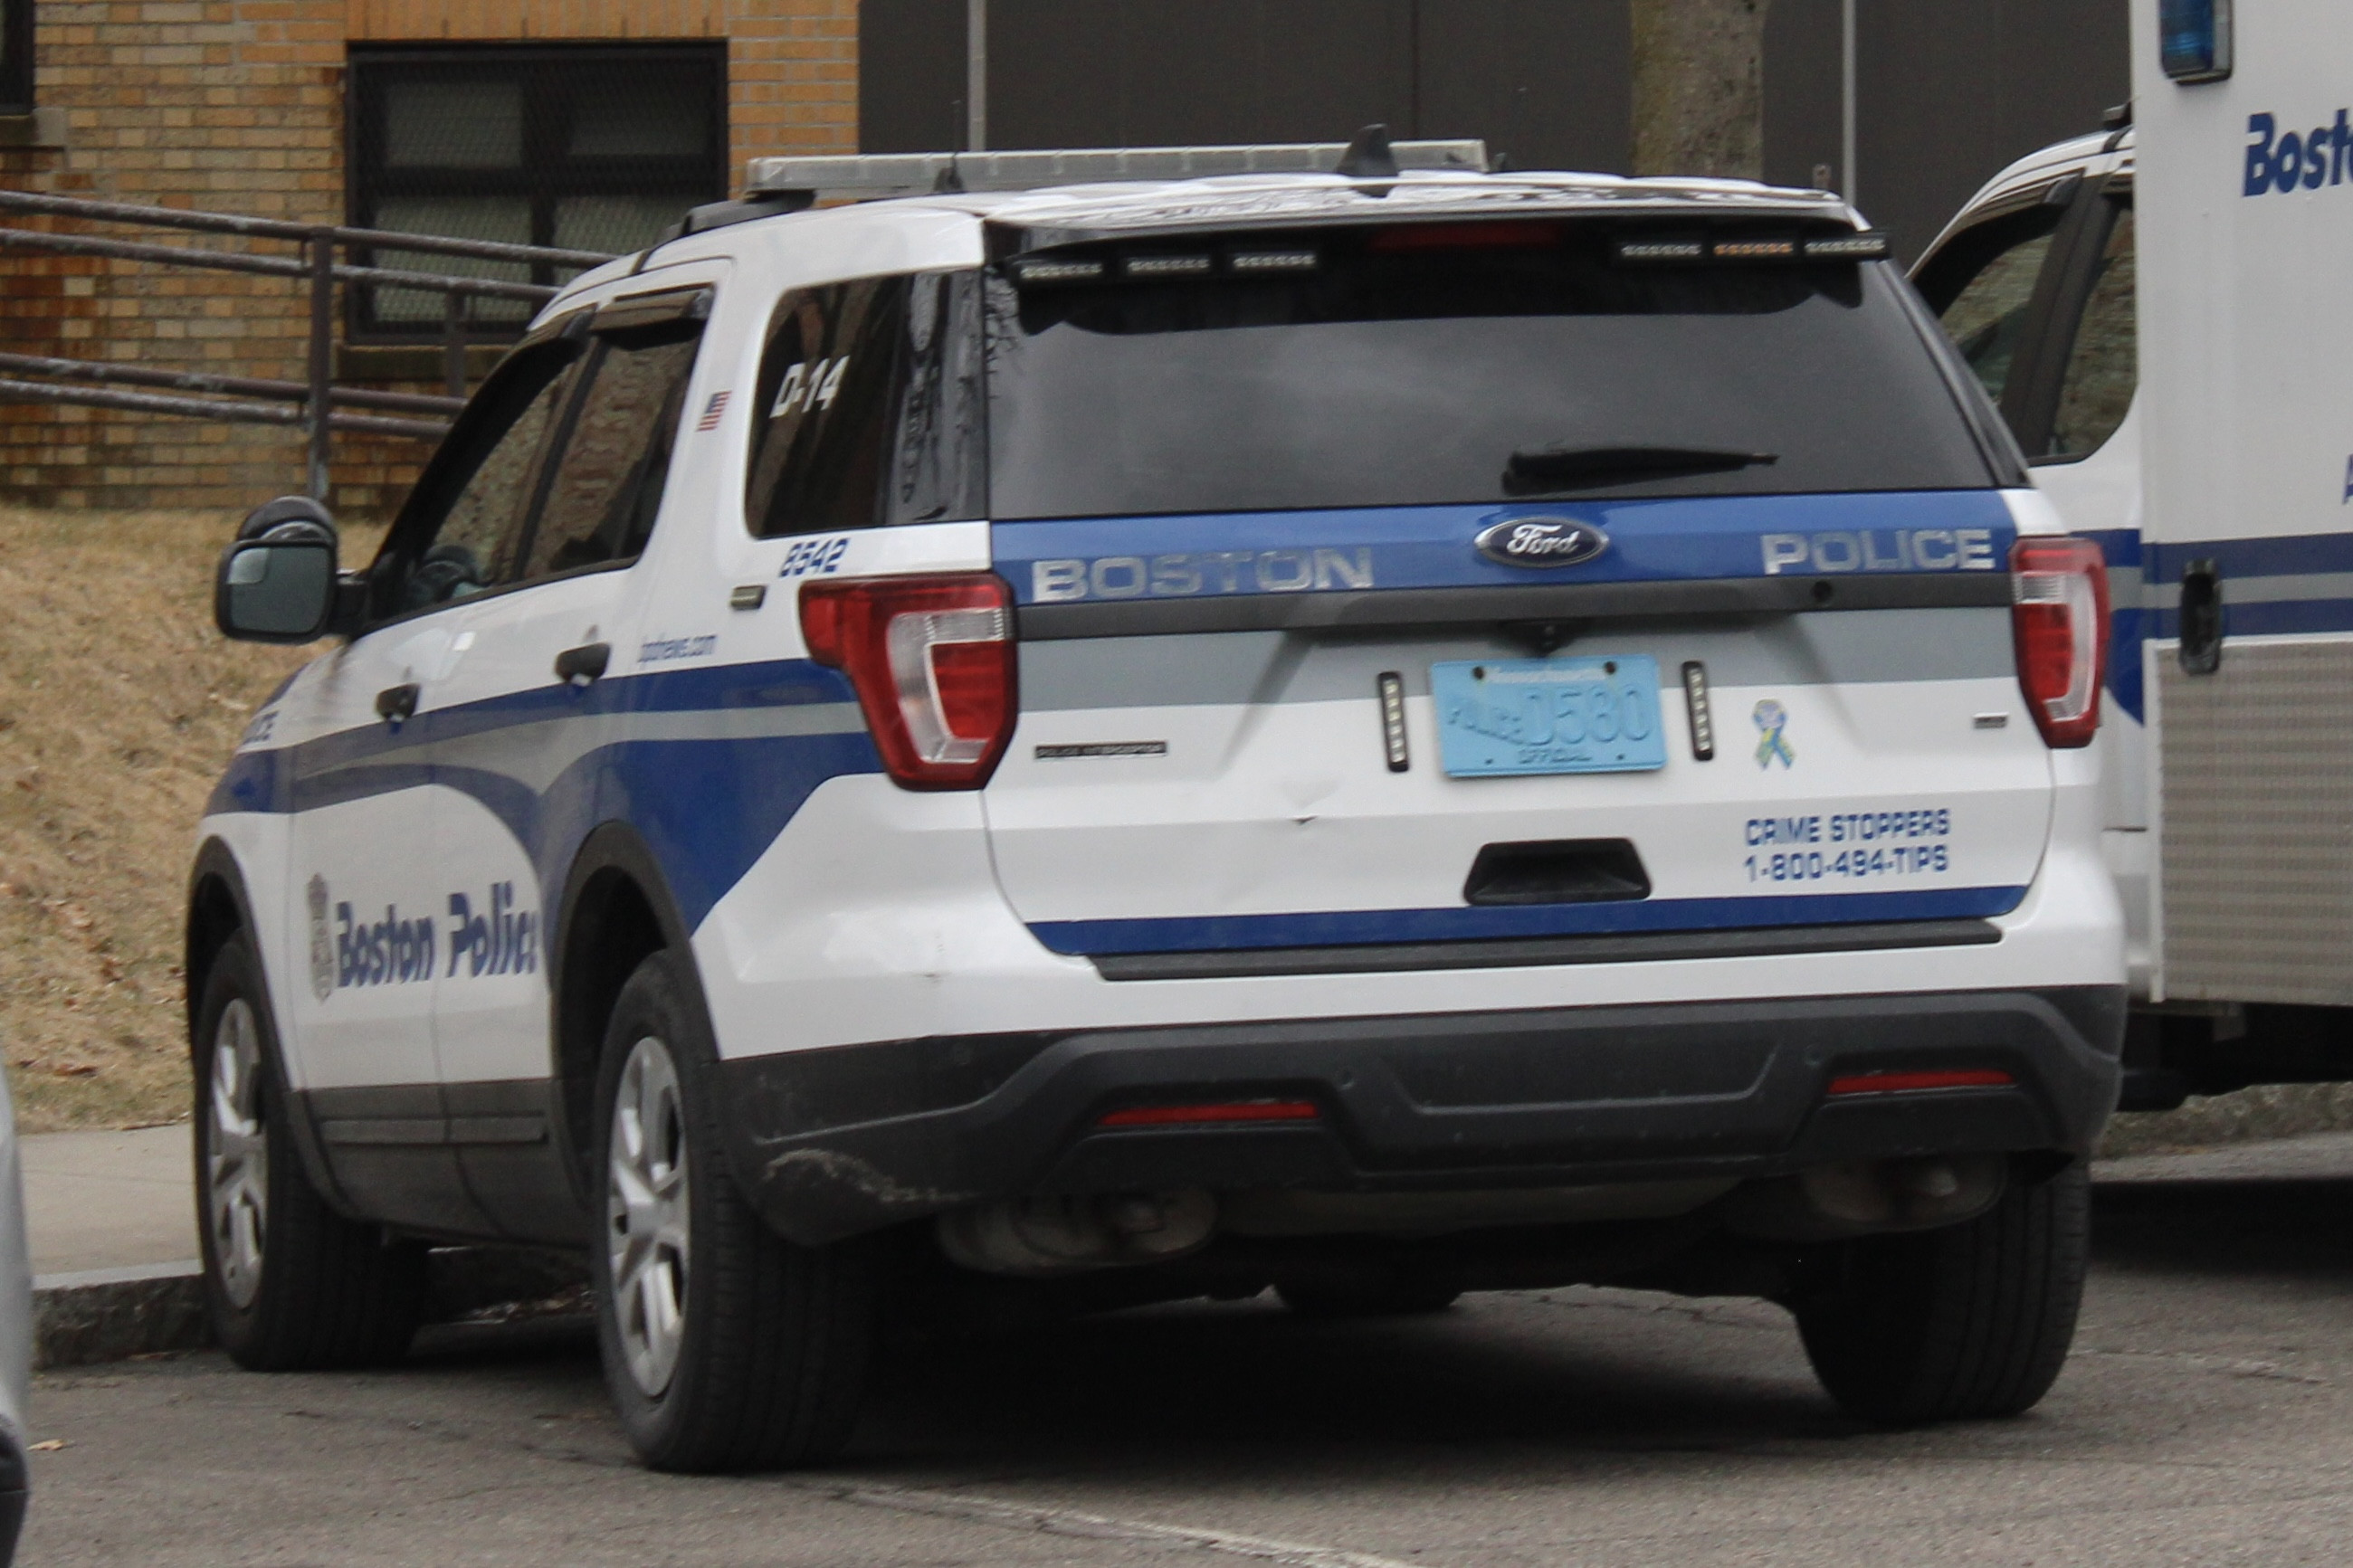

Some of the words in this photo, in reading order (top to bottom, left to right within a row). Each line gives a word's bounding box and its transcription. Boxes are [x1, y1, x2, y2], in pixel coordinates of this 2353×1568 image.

[2243, 108, 2353, 197] Bost
[769, 355, 850, 419] D-14
[1506, 524, 1581, 556] Ford
[1760, 528, 1996, 575] POLICE
[1032, 547, 1375, 603] BOSTON
[1746, 816, 1821, 847] CRIME
[1830, 808, 1950, 842] STOPPERS
[1742, 844, 1949, 883] 1-800-494-TIPS
[336, 900, 435, 987] Boston
